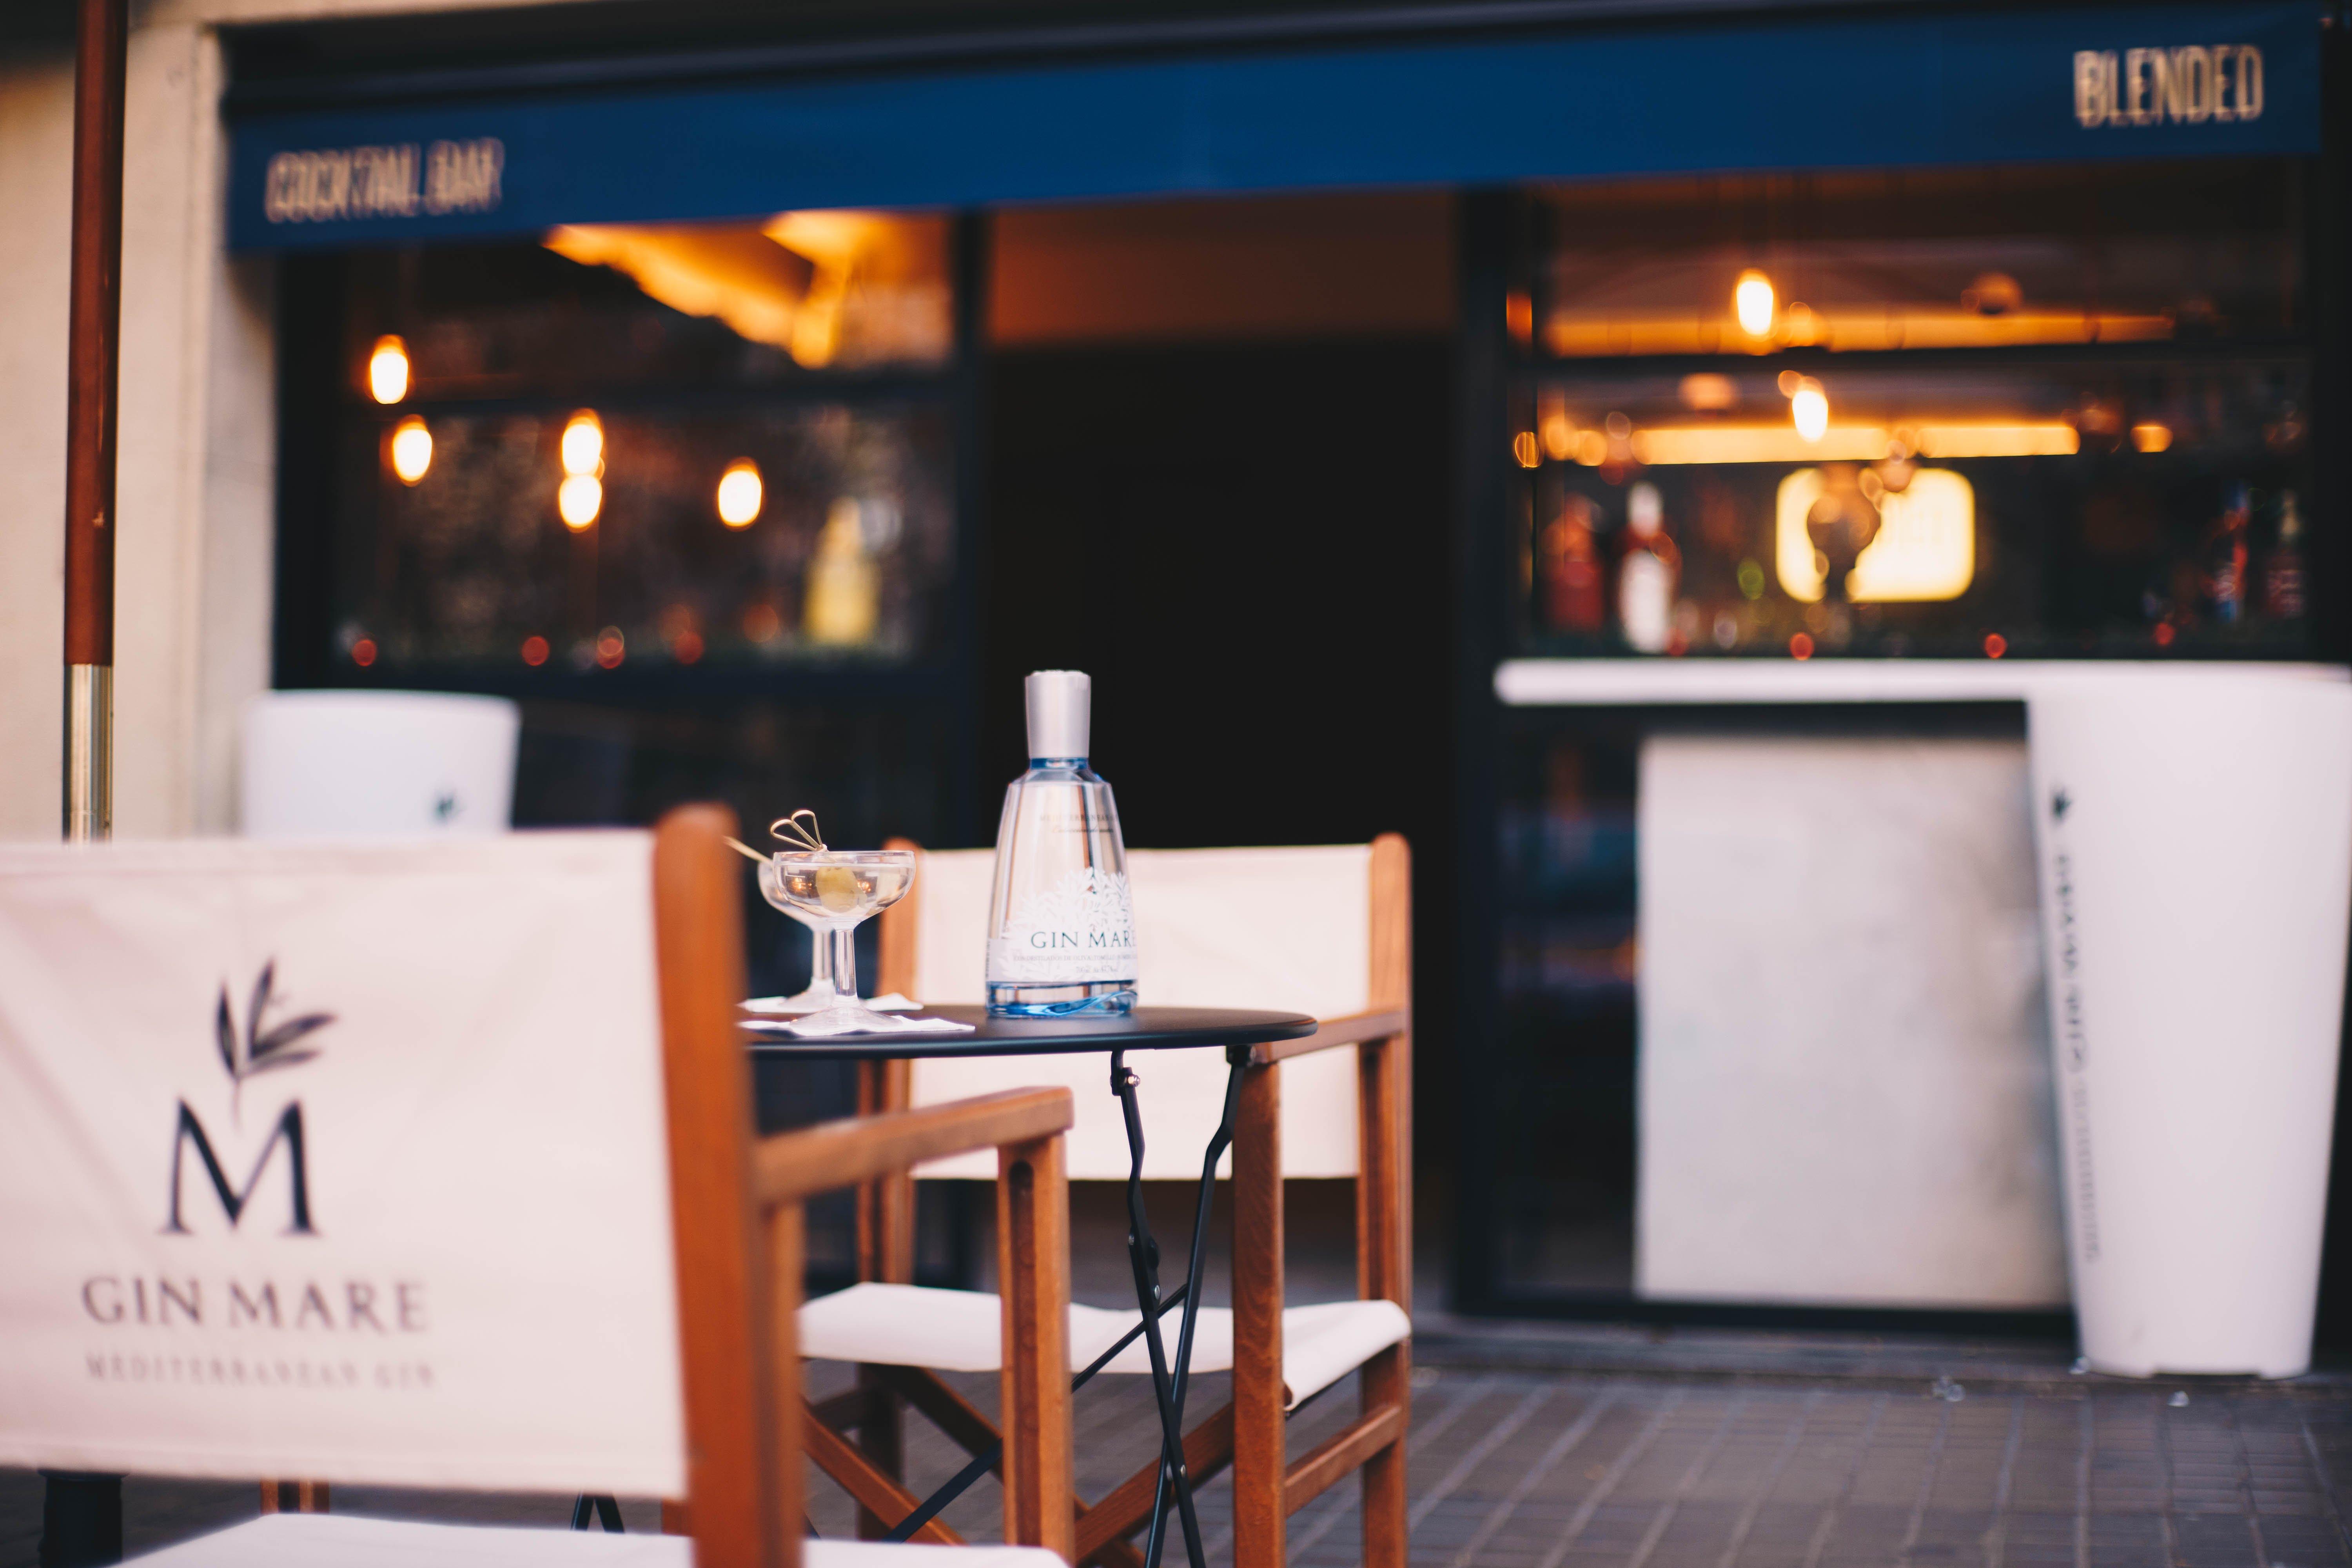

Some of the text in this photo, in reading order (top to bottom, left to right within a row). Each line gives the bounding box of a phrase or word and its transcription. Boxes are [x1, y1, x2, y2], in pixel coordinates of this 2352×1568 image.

[2075, 45, 2263, 127] BLENDED
[266, 137, 505, 222] COCKTAIL BAR
[1031, 930, 1136, 949] GIN MARE
[158, 1096, 323, 1236] M
[81, 1276, 428, 1333] GIN MARE
